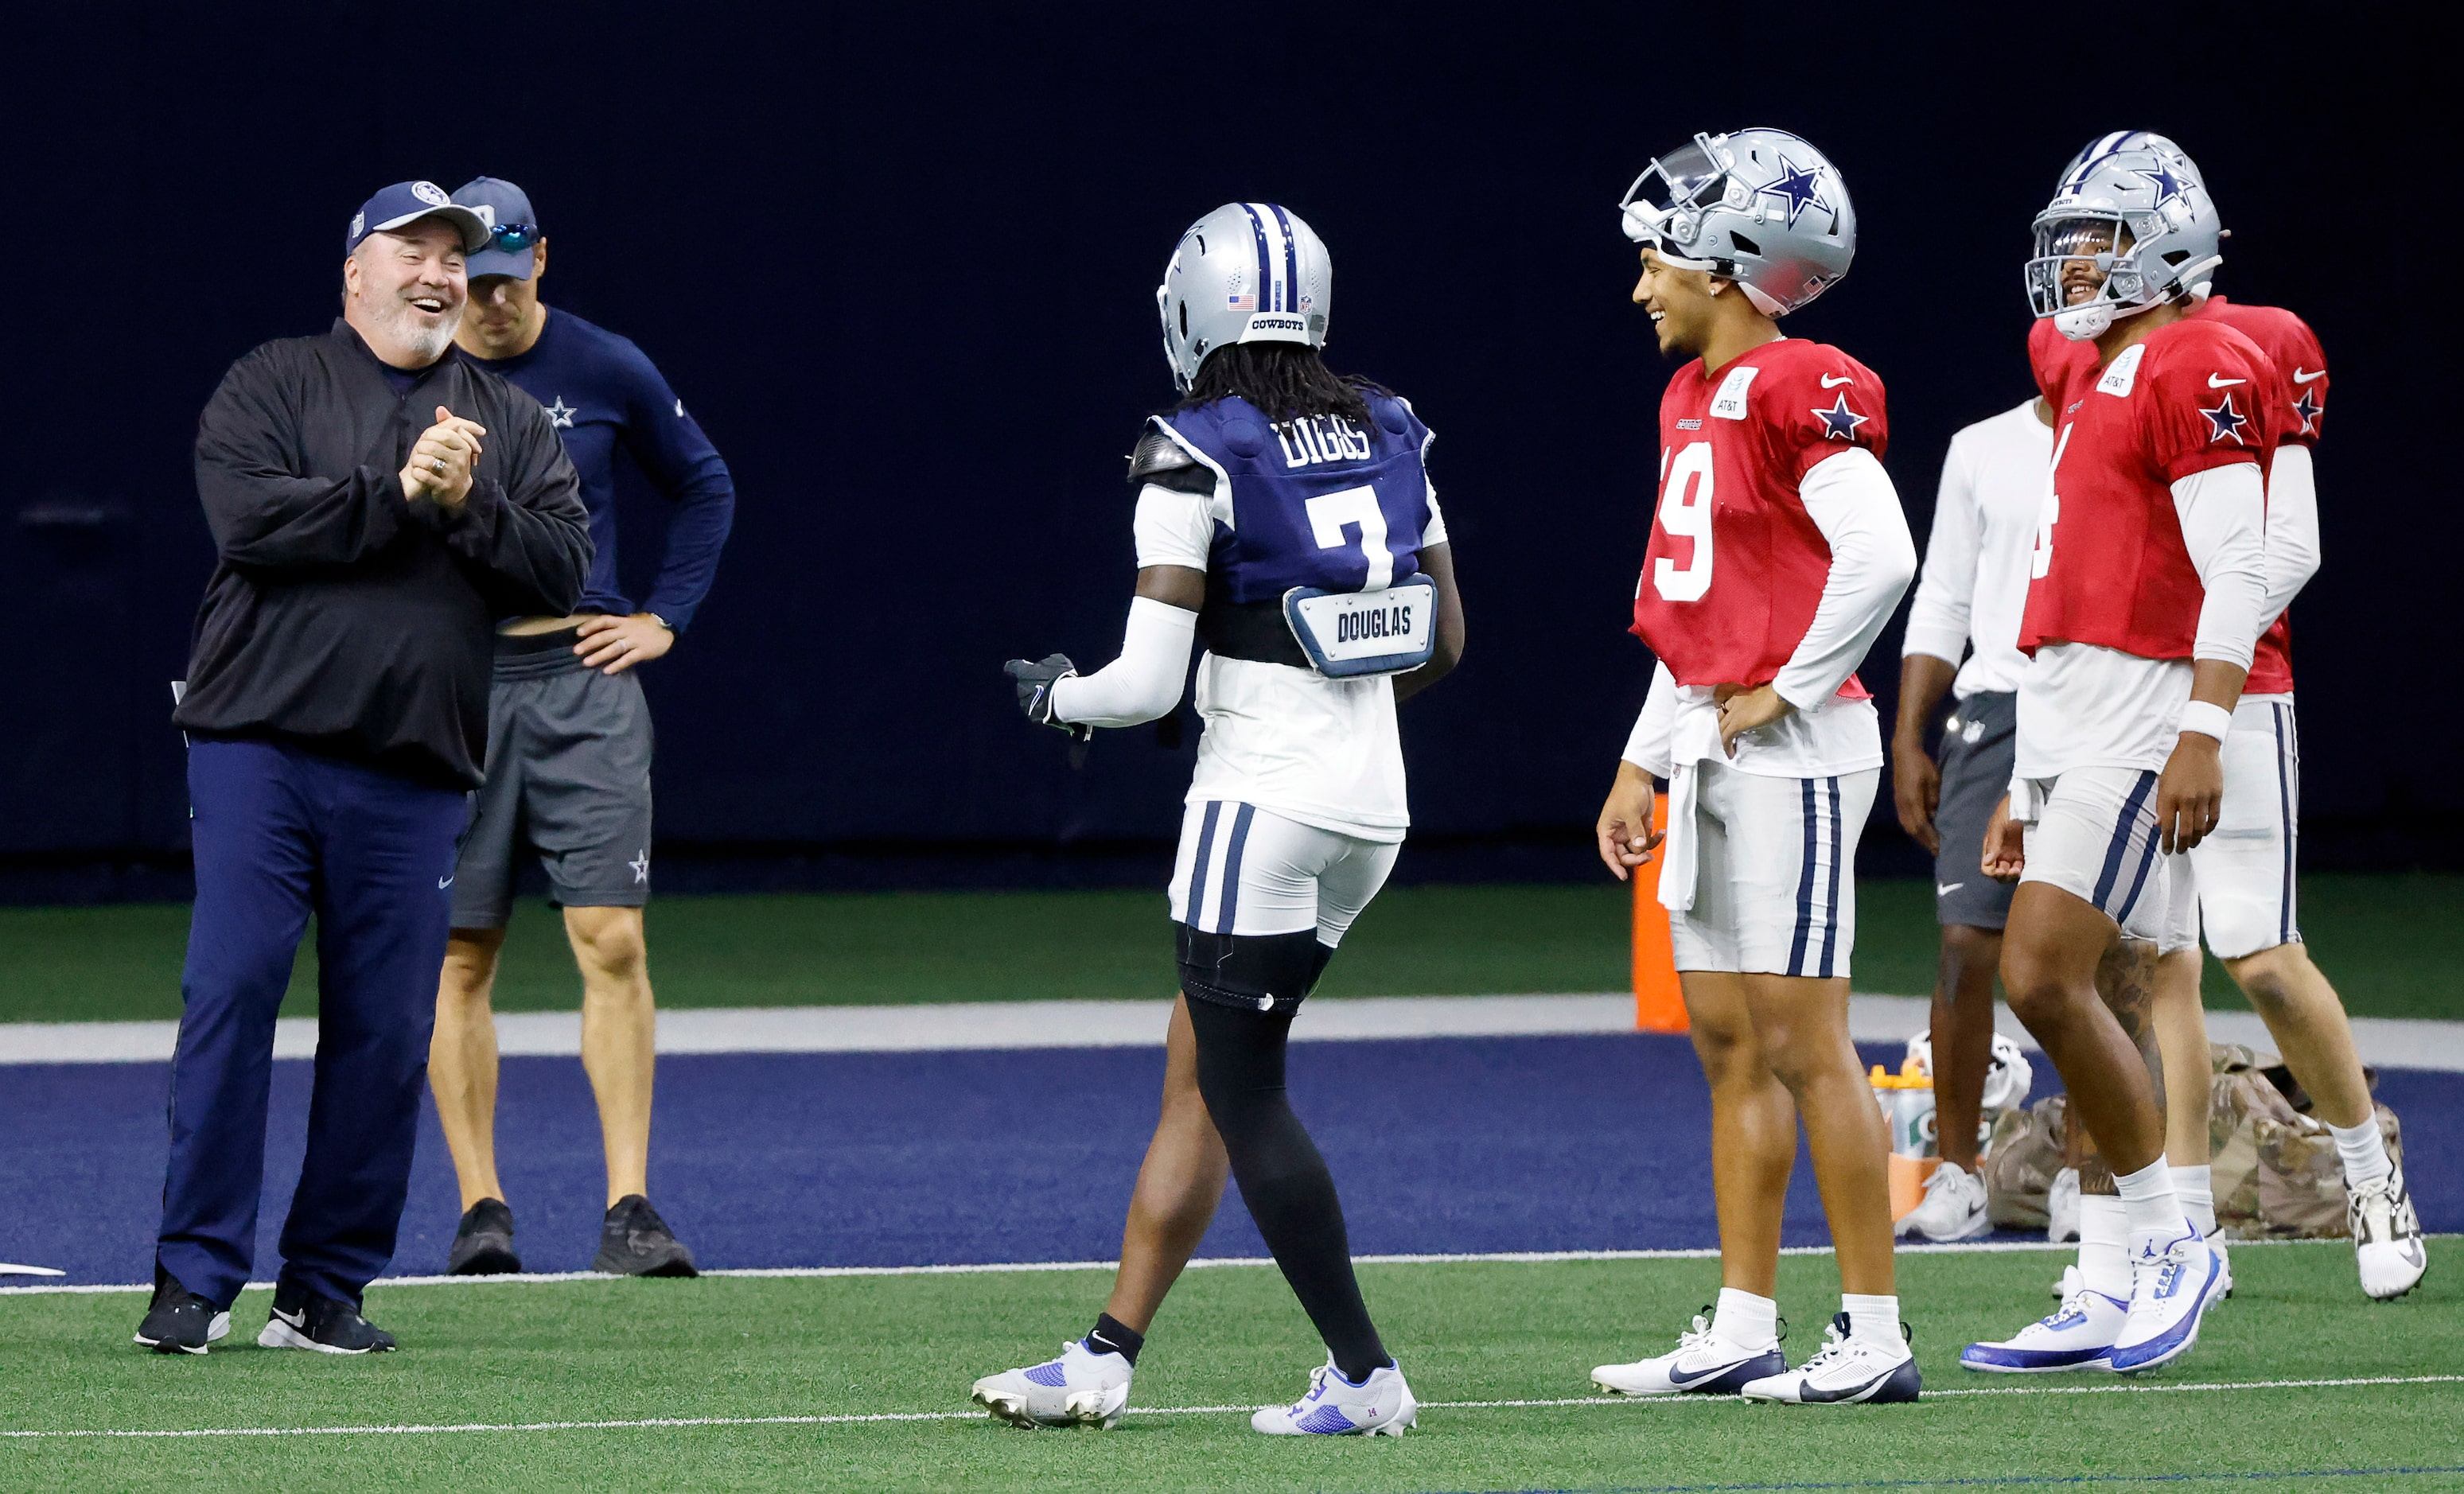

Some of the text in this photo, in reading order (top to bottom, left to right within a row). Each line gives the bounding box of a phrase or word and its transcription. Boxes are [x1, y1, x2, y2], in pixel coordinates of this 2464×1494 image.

[1251, 319, 1304, 331] COWBOYS
[2104, 375, 2125, 389] AT&T
[1717, 399, 1738, 412] AT&T
[1305, 484, 1394, 593] 7
[1337, 605, 1411, 643] DOUGLAS
